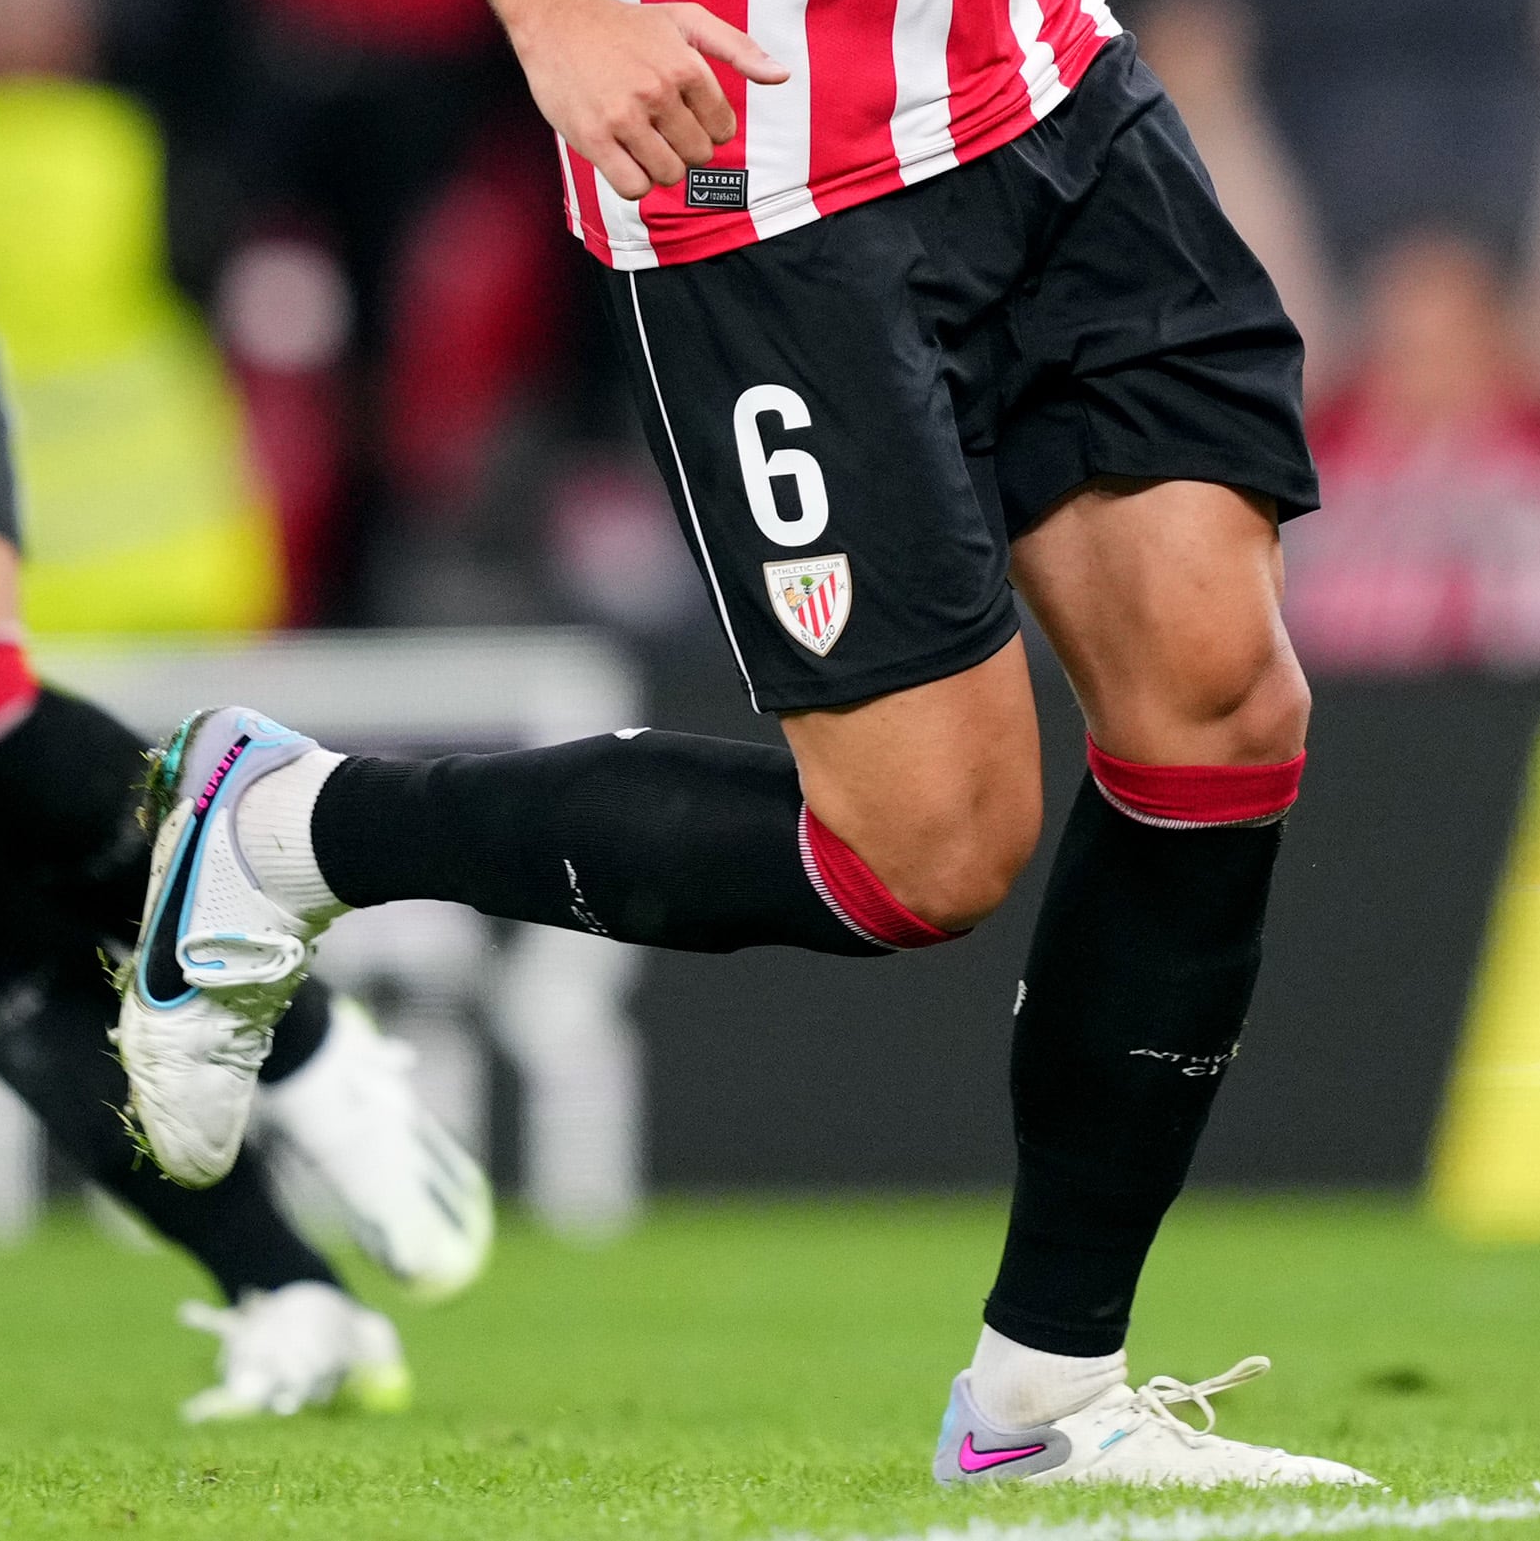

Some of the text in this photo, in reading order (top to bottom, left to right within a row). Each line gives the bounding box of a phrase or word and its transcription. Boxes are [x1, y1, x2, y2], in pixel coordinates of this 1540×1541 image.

[692, 174, 741, 185] CASTORE
[733, 384, 829, 547] 6
[772, 561, 841, 576] ATHLETIC CLUB
[800, 624, 835, 650] BILBAO
